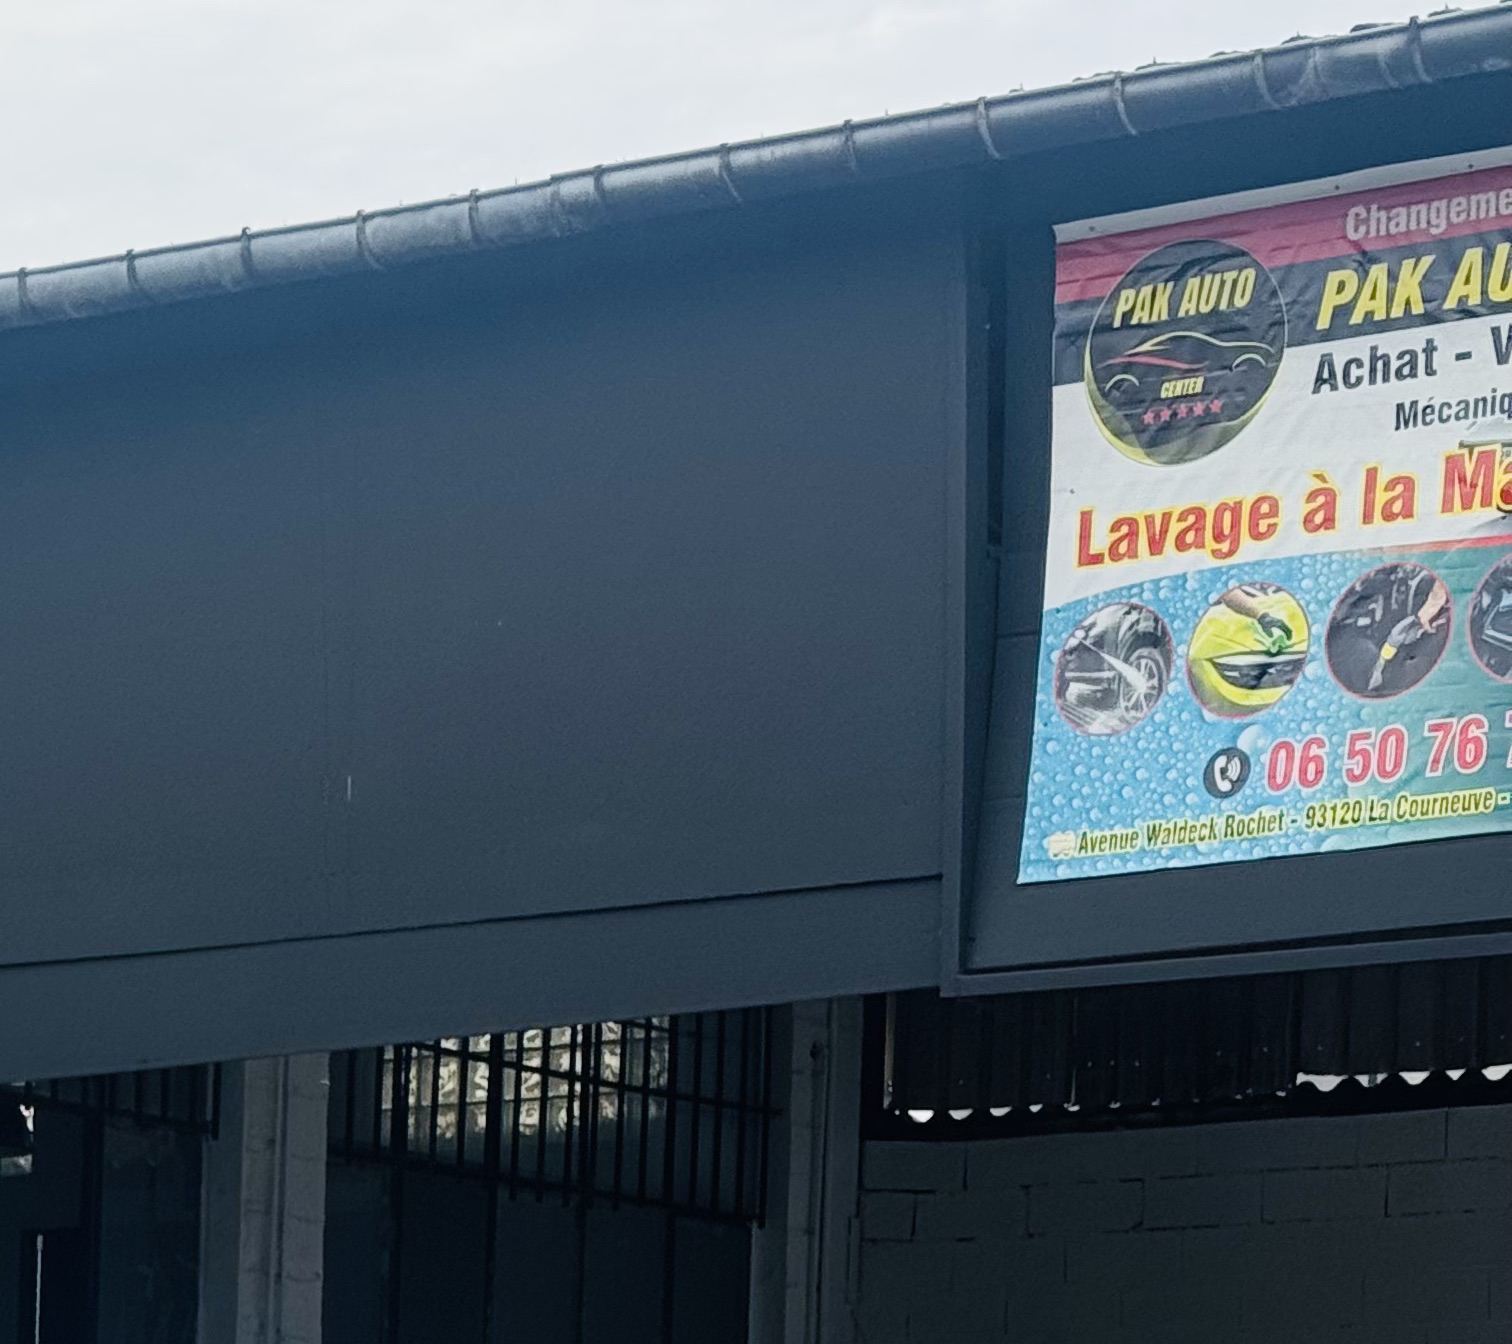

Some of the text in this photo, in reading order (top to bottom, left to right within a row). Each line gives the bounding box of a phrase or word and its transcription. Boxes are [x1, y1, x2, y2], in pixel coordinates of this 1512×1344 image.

[1113, 267, 1257, 329] PAK AUTO
[1315, 254, 1437, 331] PAK
[1160, 376, 1205, 399] CENTER
[1311, 337, 1439, 395] Achat
[1077, 494, 1281, 568] Lavage
[1302, 472, 1338, 534] à
[1361, 467, 1416, 526] la
[1266, 736, 1327, 793] 06
[1344, 724, 1409, 785] 50
[1424, 713, 1490, 779] 76
[1078, 829, 1140, 855] Avenue
[1146, 819, 1218, 848] Waldeck
[1224, 810, 1286, 839] Rochet
[1305, 799, 1362, 829] 93120
[1368, 799, 1388, 822] La
[1395, 790, 1494, 820] Courneuve
